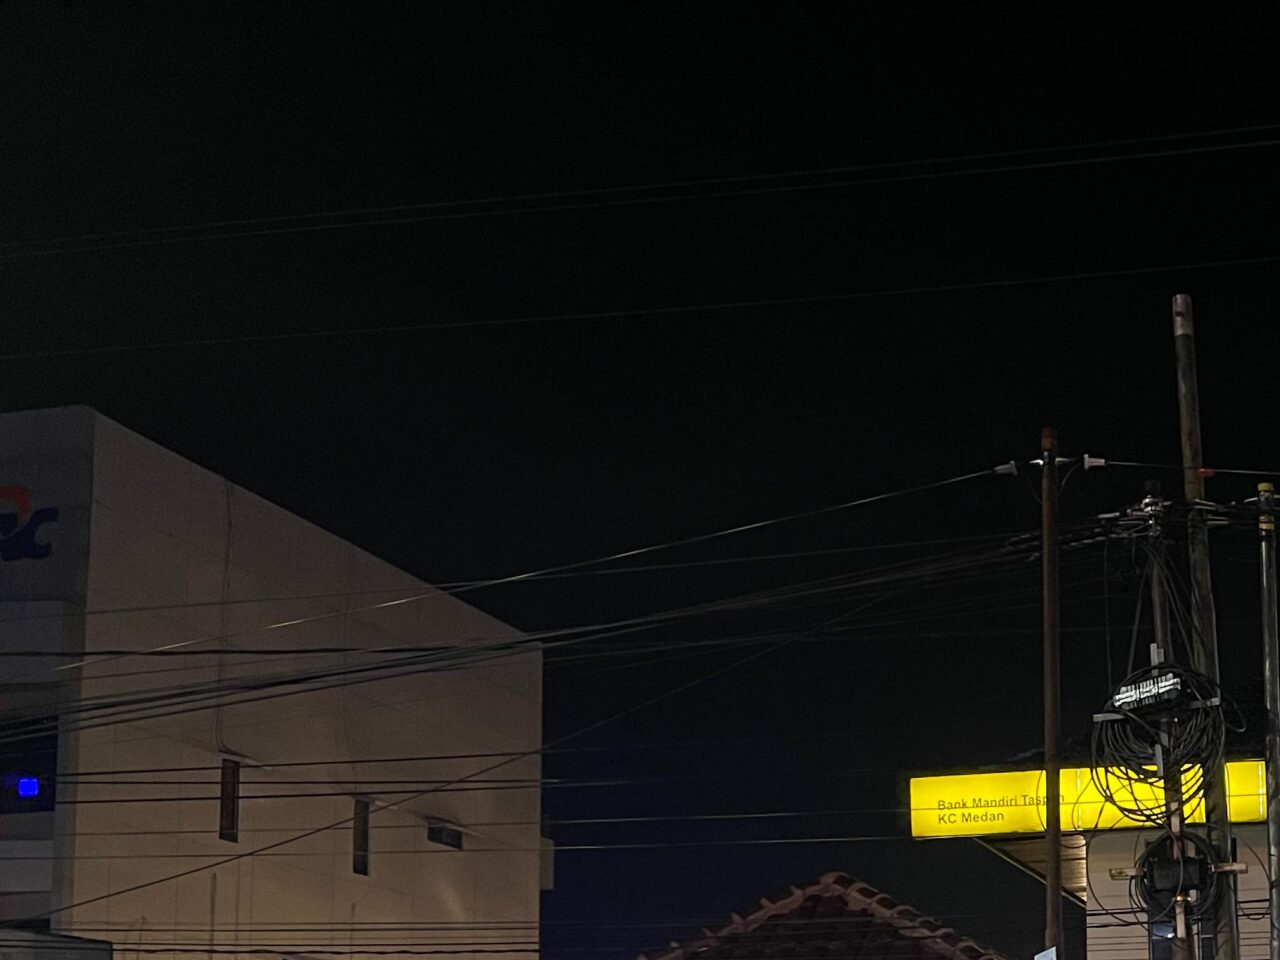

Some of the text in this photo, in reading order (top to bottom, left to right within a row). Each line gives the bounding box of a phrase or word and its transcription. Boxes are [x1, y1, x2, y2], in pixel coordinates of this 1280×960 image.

[938, 798, 968, 810] Bank
[972, 796, 1018, 808] Mandiri
[938, 811, 1005, 824] KC Medan
